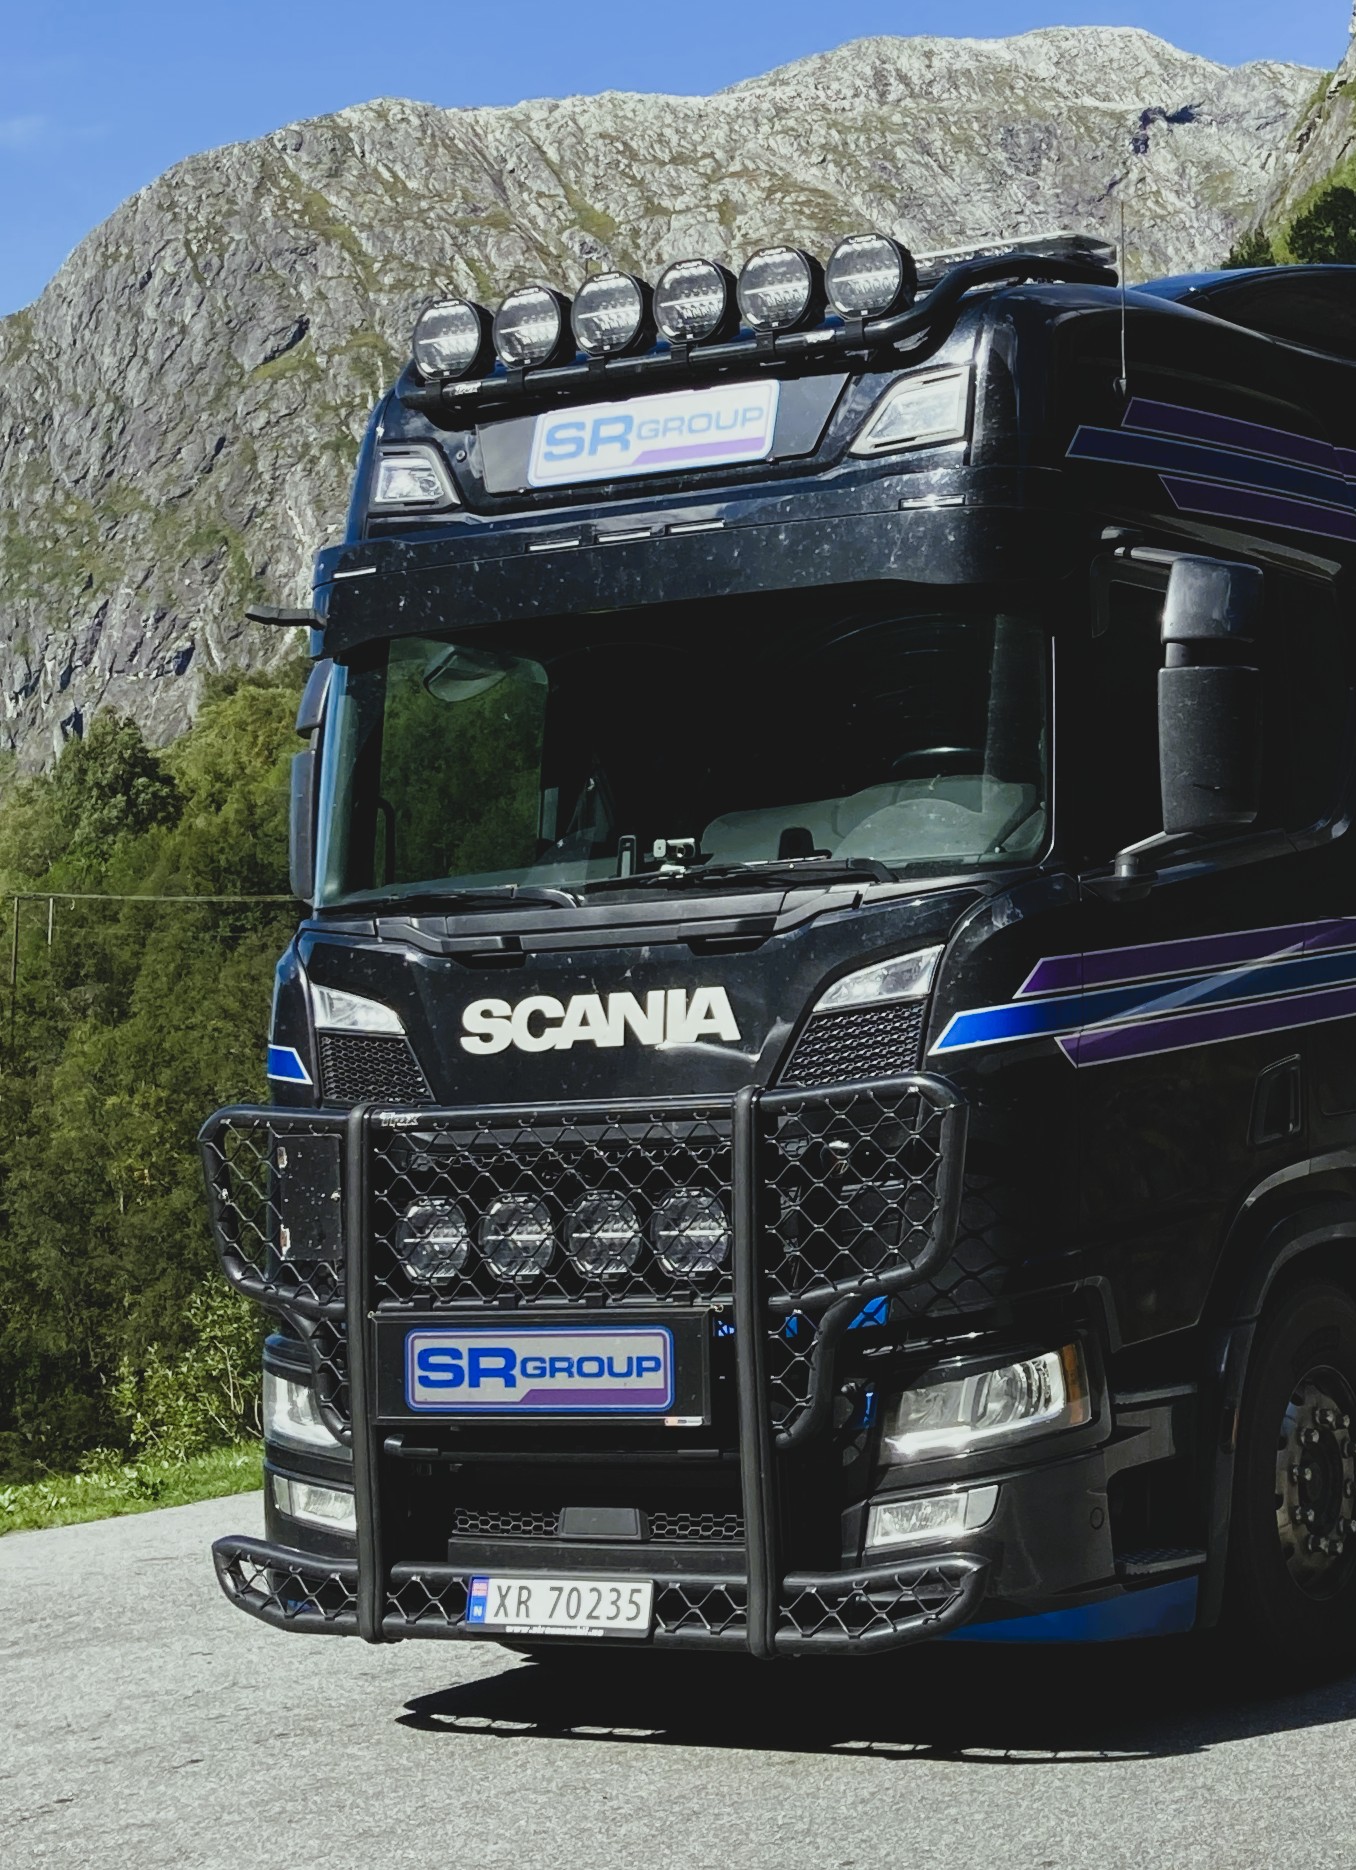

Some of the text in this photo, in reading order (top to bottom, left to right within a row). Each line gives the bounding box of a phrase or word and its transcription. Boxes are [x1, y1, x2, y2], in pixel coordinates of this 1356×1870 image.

[544, 406, 764, 462] SR GROUP
[460, 986, 741, 1055] SCANIA
[417, 1347, 662, 1388] SR GROUP
[473, 1606, 483, 1617] N
[493, 1585, 642, 1621] XR 70235
